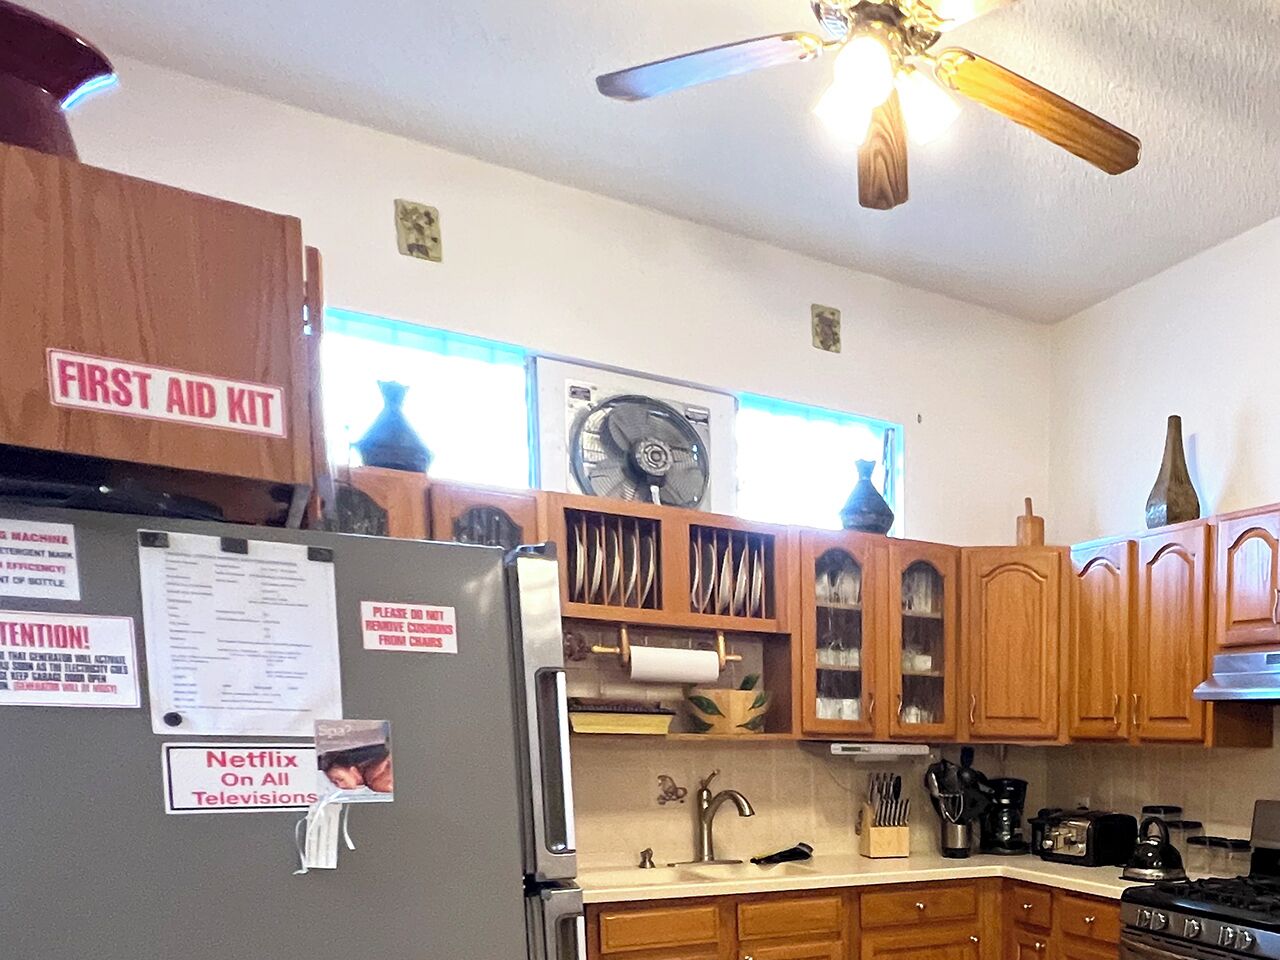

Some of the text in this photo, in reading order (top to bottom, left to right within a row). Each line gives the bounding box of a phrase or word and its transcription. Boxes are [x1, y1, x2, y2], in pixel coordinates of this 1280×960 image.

[57, 359, 274, 428] FIRST AID KIT
[11, 532, 69, 545] MACHINE
[13, 576, 25, 585] OF
[28, 577, 65, 588] BOTTLE
[372, 606, 444, 621] PLEASE DO NOT
[365, 620, 405, 632] REMOVE
[379, 634, 443, 648] FROM CHAIRS
[8, 652, 26, 661] THAT
[29, 652, 73, 662] GENERATOR
[74, 654, 91, 663] WILL
[94, 655, 126, 664] ACTIVATE
[12, 662, 34, 671] SOON
[36, 663, 47, 672] AS
[49, 663, 62, 672] THE
[64, 664, 108, 674] ELECTRICITY
[110, 665, 128, 674] GOES
[11, 672, 29, 681] KEEP
[32, 672, 62, 682] GARAGE
[64, 673, 85, 683] DOOR
[87, 674, 107, 683] OPEN
[318, 724, 352, 740] Spa?
[206, 750, 299, 768] Netflix
[221, 772, 289, 787] On All
[192, 790, 319, 806] Televisions
